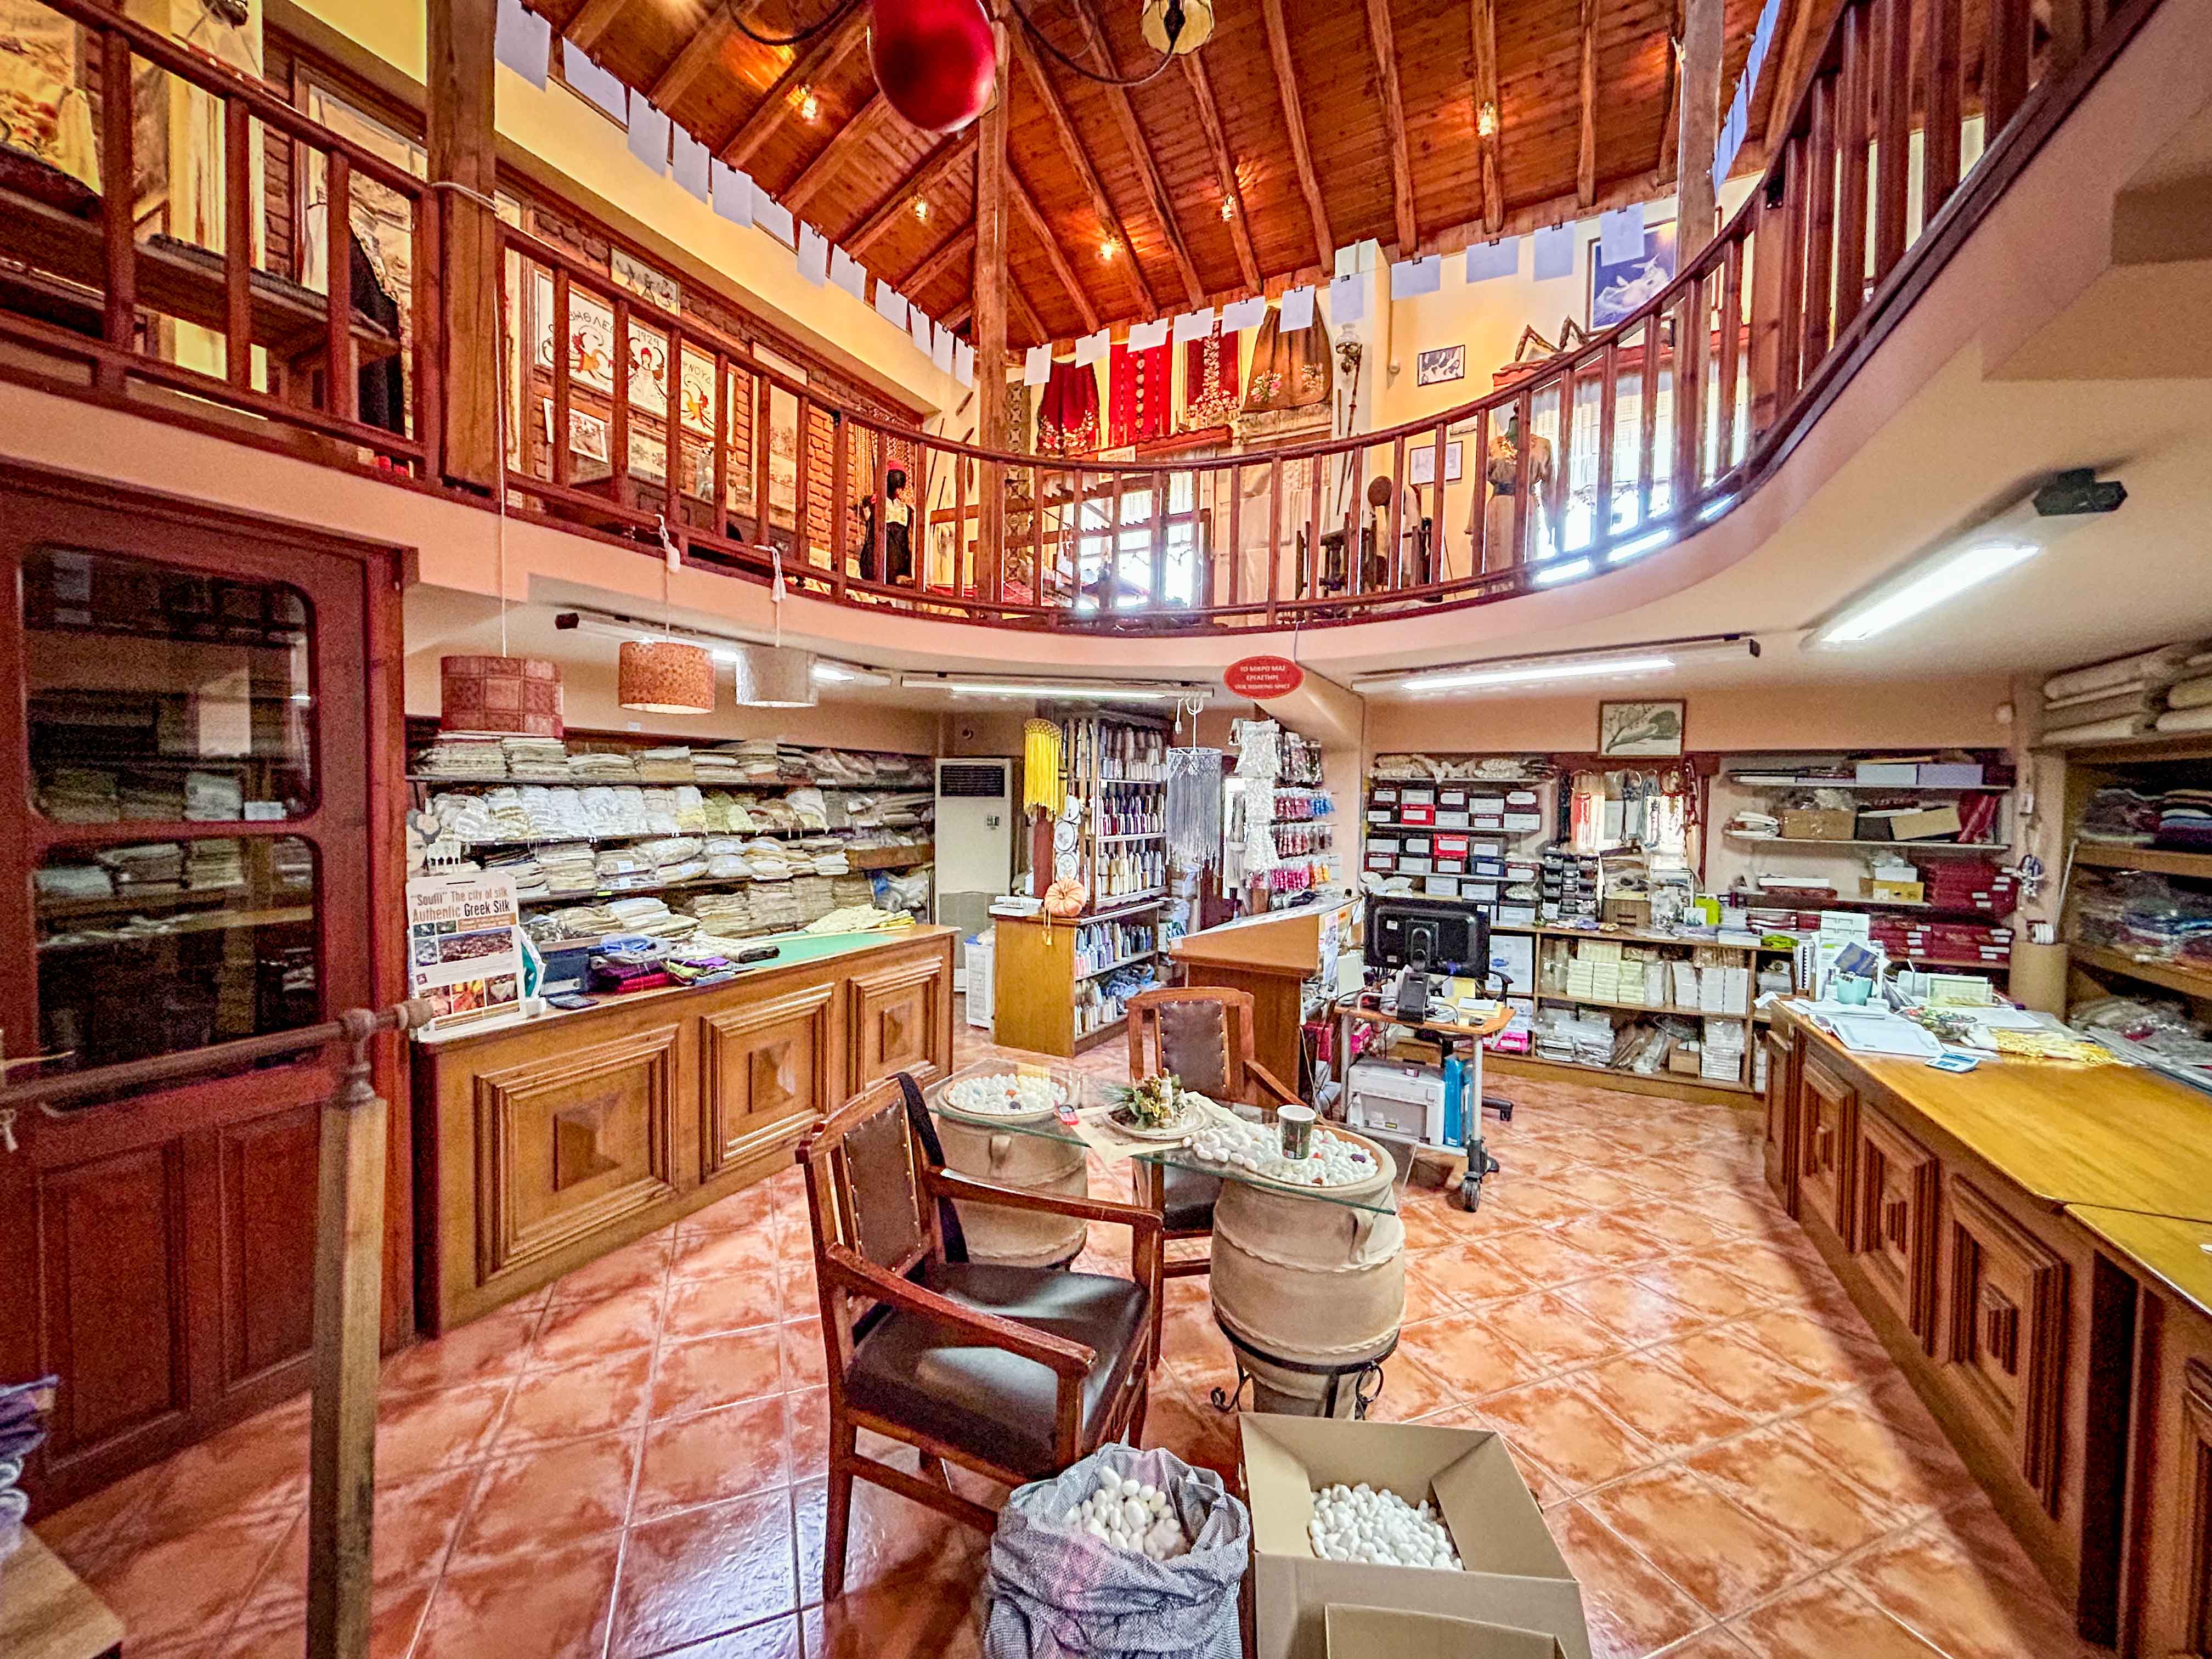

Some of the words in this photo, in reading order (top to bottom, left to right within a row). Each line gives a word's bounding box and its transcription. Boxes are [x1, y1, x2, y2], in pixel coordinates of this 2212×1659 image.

[636, 329, 659, 347] 1929
[451, 890, 466, 902] The
[468, 889, 482, 901] city
[486, 888, 492, 899] of
[494, 886, 509, 899] silk
[413, 906, 461, 923] Authentic
[464, 901, 490, 917] Greek
[493, 900, 510, 913] Silk
